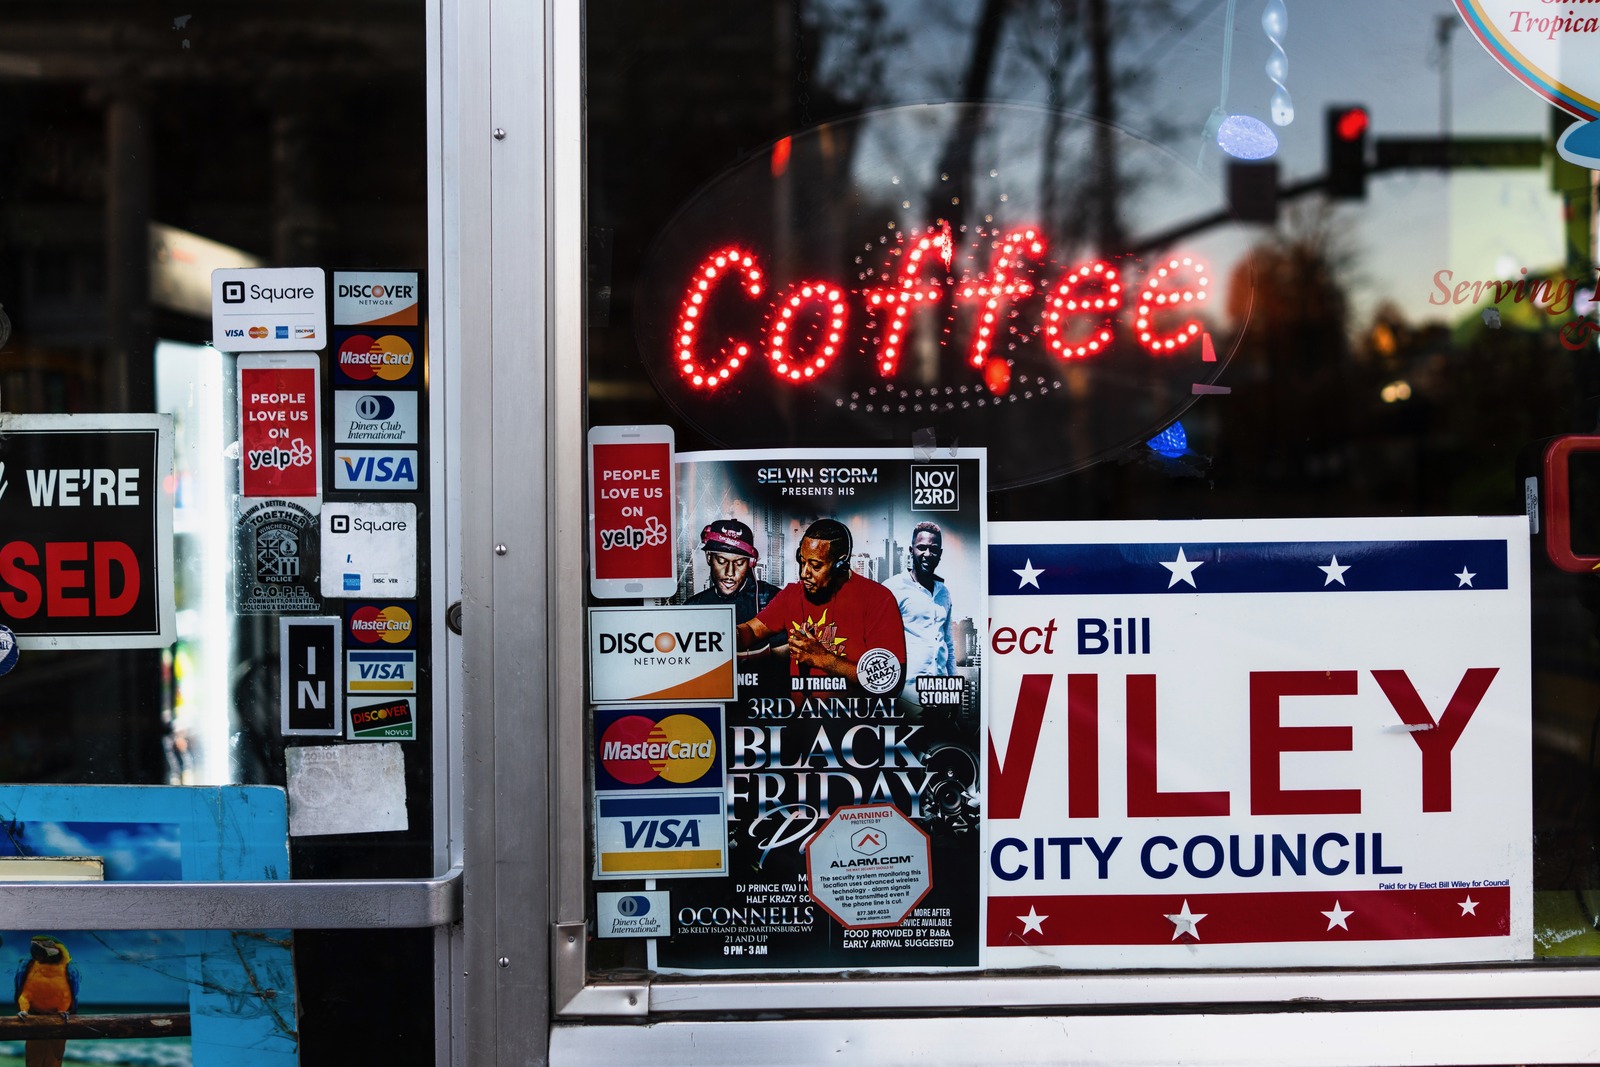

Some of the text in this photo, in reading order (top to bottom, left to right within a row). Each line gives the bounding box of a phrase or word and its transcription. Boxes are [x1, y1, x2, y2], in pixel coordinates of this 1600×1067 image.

[250, 285, 314, 303] Square
[338, 285, 412, 299] DISCOVER
[1429, 267, 1579, 316] Serving
[675, 221, 1212, 390] Coffee
[225, 329, 244, 337] VISA
[340, 351, 412, 365] MasterCard
[251, 393, 306, 404] PEOPLE
[249, 411, 308, 421] LOVE US
[350, 421, 401, 431] Diners Club
[268, 428, 289, 439] ON
[348, 430, 404, 439] International
[249, 447, 291, 470] yelp
[338, 456, 414, 482] VISA
[603, 469, 660, 480] PEOPLE
[757, 467, 878, 484] SELVIN STORM
[915, 471, 955, 487] NOV
[26, 468, 140, 507] WE'RE
[601, 487, 663, 499] LOVE US
[781, 487, 855, 496] PRESENTS HIS
[914, 489, 955, 504] 23RD
[287, 501, 318, 526] COMMUNITY
[621, 506, 643, 517] ON
[250, 510, 306, 528] TOGETHER
[259, 523, 298, 534] WINCHESTER
[354, 518, 406, 534] Square
[601, 526, 646, 549] yelp
[0, 540, 141, 619] SED
[253, 586, 310, 597] C.O.P.E.
[352, 619, 410, 631] MasterCard
[600, 631, 723, 654] DISCOVER
[988, 617, 1151, 655] ect Bill
[634, 656, 691, 666] NETWORK
[866, 660, 888, 675] HALF
[358, 663, 404, 679] VISA
[866, 665, 895, 683] KRAZY
[791, 677, 847, 690] DJ TRIGGA
[918, 678, 963, 691] MARLON
[921, 691, 960, 704] STORM
[353, 705, 407, 724] DISCOVER
[748, 697, 905, 719] 3RD ANNUAL
[603, 739, 712, 761] MasterCard
[729, 724, 927, 770] BLACK
[727, 770, 938, 821] FRIDAY
[839, 810, 893, 820] WARNING!
[619, 819, 700, 848] VISA
[748, 803, 820, 869] P
[830, 855, 911, 868] ALARM.COM
[990, 832, 1403, 881] CITY COUNCIL
[878, 870, 909, 878] monitoring
[736, 884, 746, 893] DJ
[748, 884, 779, 892] PRINCE
[782, 884, 797, 892] (VA)
[832, 887, 866, 895] technology
[1408, 882, 1417, 890] by
[1420, 881, 1436, 889] Elect
[1451, 880, 1470, 888] Wiley
[746, 895, 815, 904] HALF KRAZY SO
[678, 906, 814, 926] OCONNELLS
[914, 908, 931, 917] MORE
[931, 908, 951, 916] AFTER
[612, 917, 657, 926] Diners Club
[921, 919, 952, 927] AVAILABLE
[611, 925, 659, 934] International
[690, 926, 710, 934] KELLY
[844, 929, 951, 938] FOOD PROVIDED BY BABA
[724, 935, 768, 943] 21 AND UP
[843, 939, 954, 948] EARLY ARRIVAL SUGGESTED
[723, 946, 729, 955] 9
[731, 946, 743, 955] PM
[749, 946, 754, 954] 3
[755, 946, 768, 954] AM
